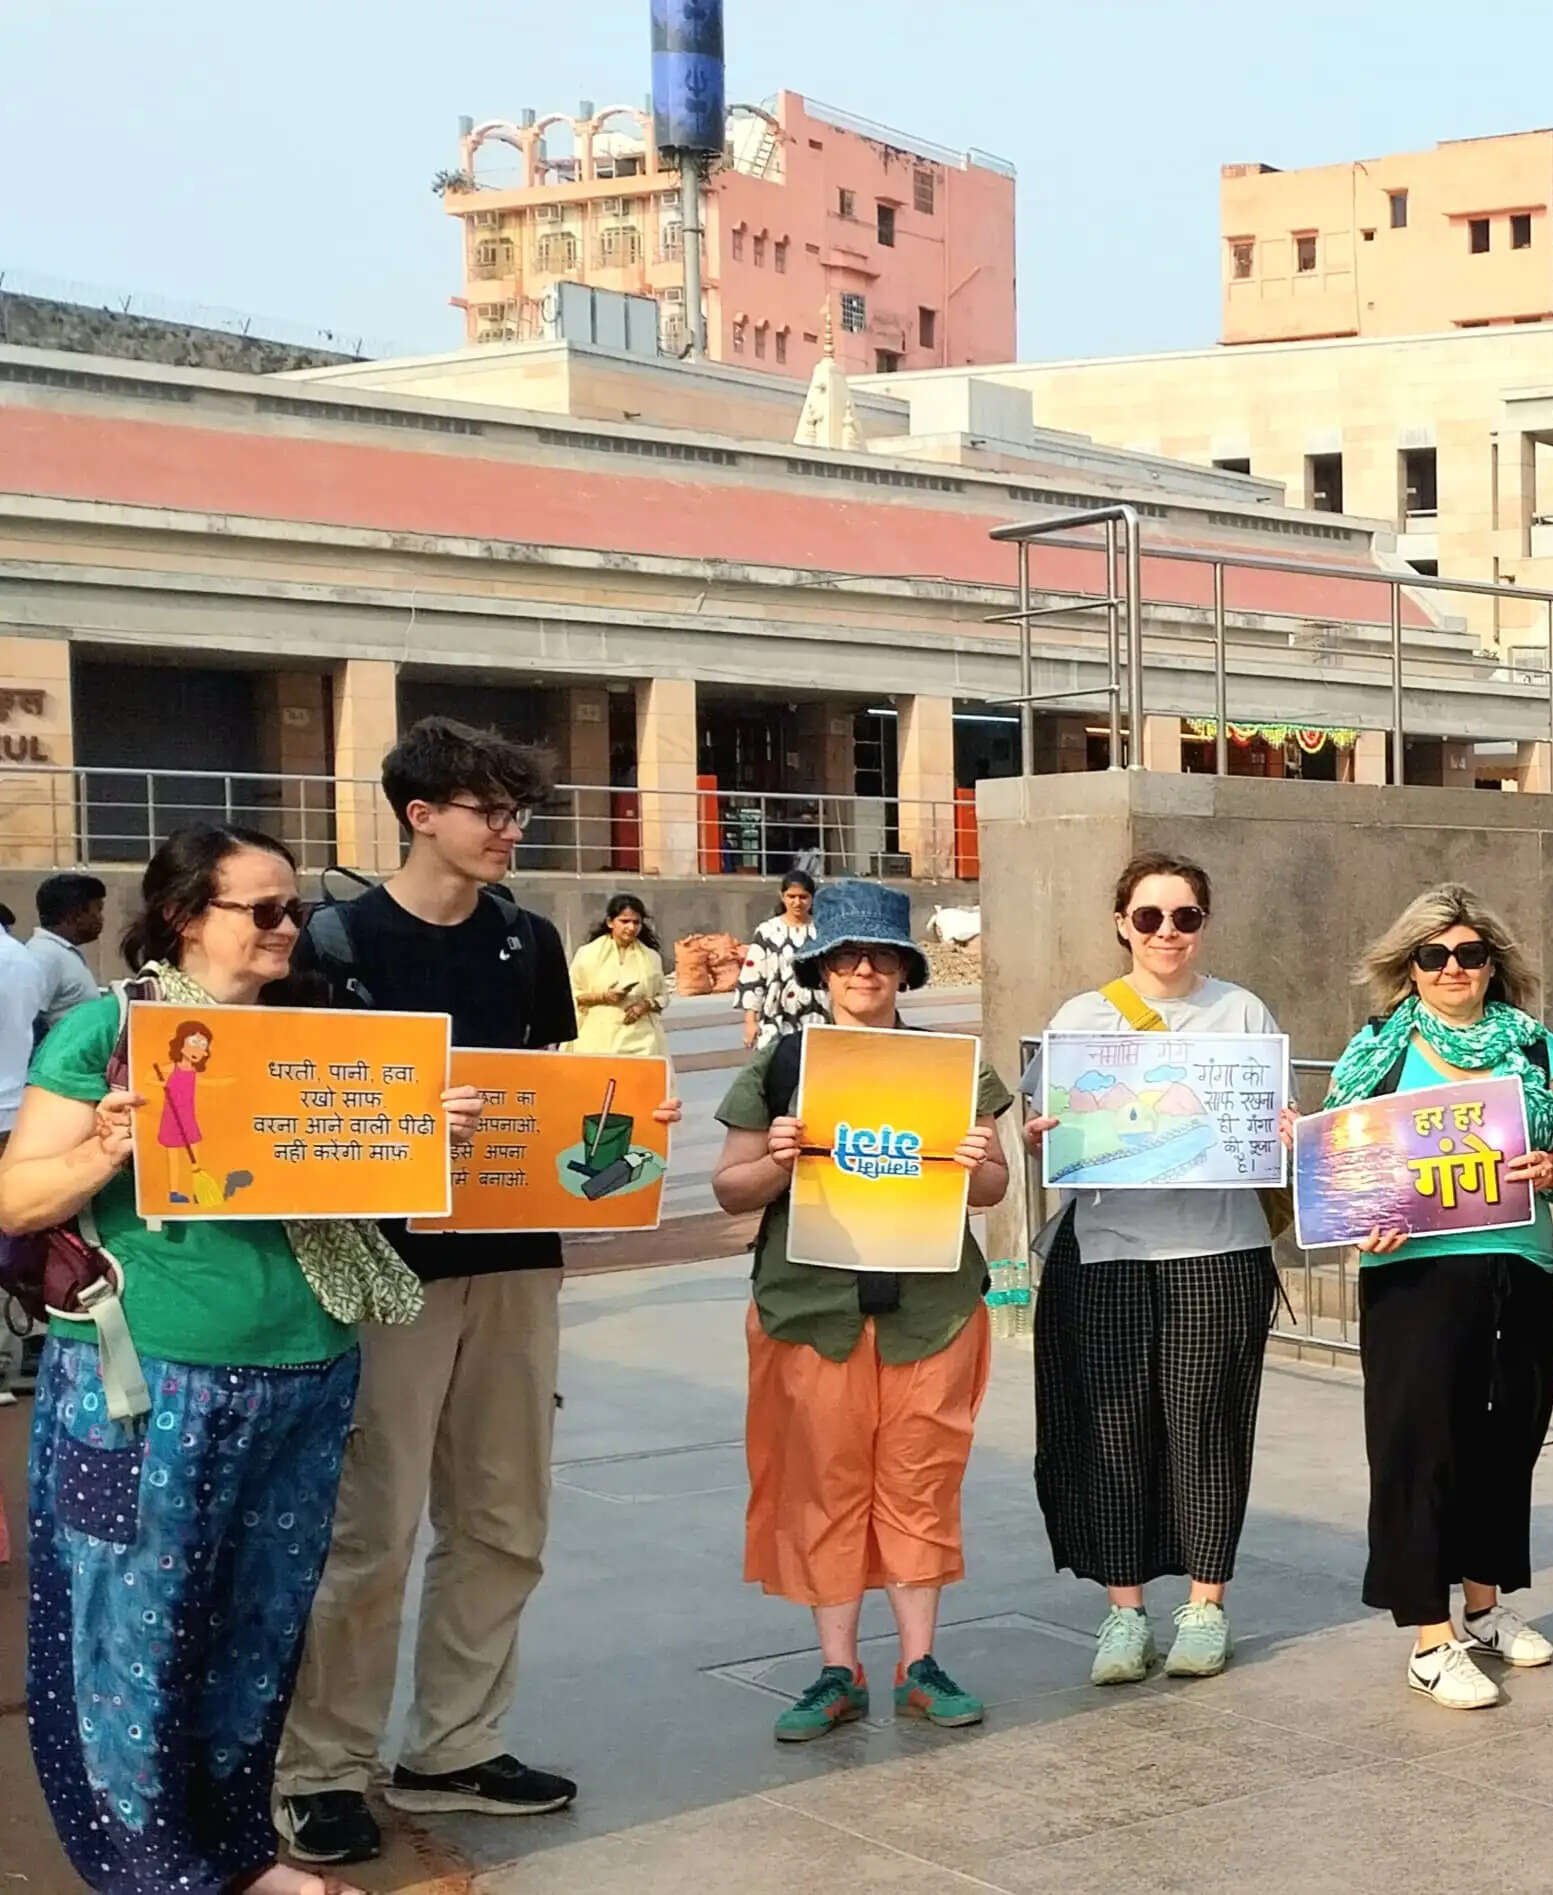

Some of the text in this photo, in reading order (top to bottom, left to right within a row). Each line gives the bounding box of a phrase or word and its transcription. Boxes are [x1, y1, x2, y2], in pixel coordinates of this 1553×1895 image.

[0, 735, 48, 761] UL
[1193, 1056, 1271, 1087] गंगा को
[301, 1086, 336, 1108] रखो
[517, 1092, 537, 1104] का
[1204, 1090, 1275, 1112] साफ रखना
[254, 1117, 298, 1133] वरना
[306, 1113, 343, 1134] आने
[350, 1113, 392, 1135] वाली
[1217, 1112, 1275, 1134] ही गंगा
[1413, 1101, 1485, 1137] हर हर
[274, 1139, 307, 1163] नहीं
[314, 1139, 362, 1162] करेंगी
[484, 1145, 527, 1159] अपना
[1248, 1140, 1277, 1156] पूजा
[1407, 1132, 1504, 1209] गंगे
